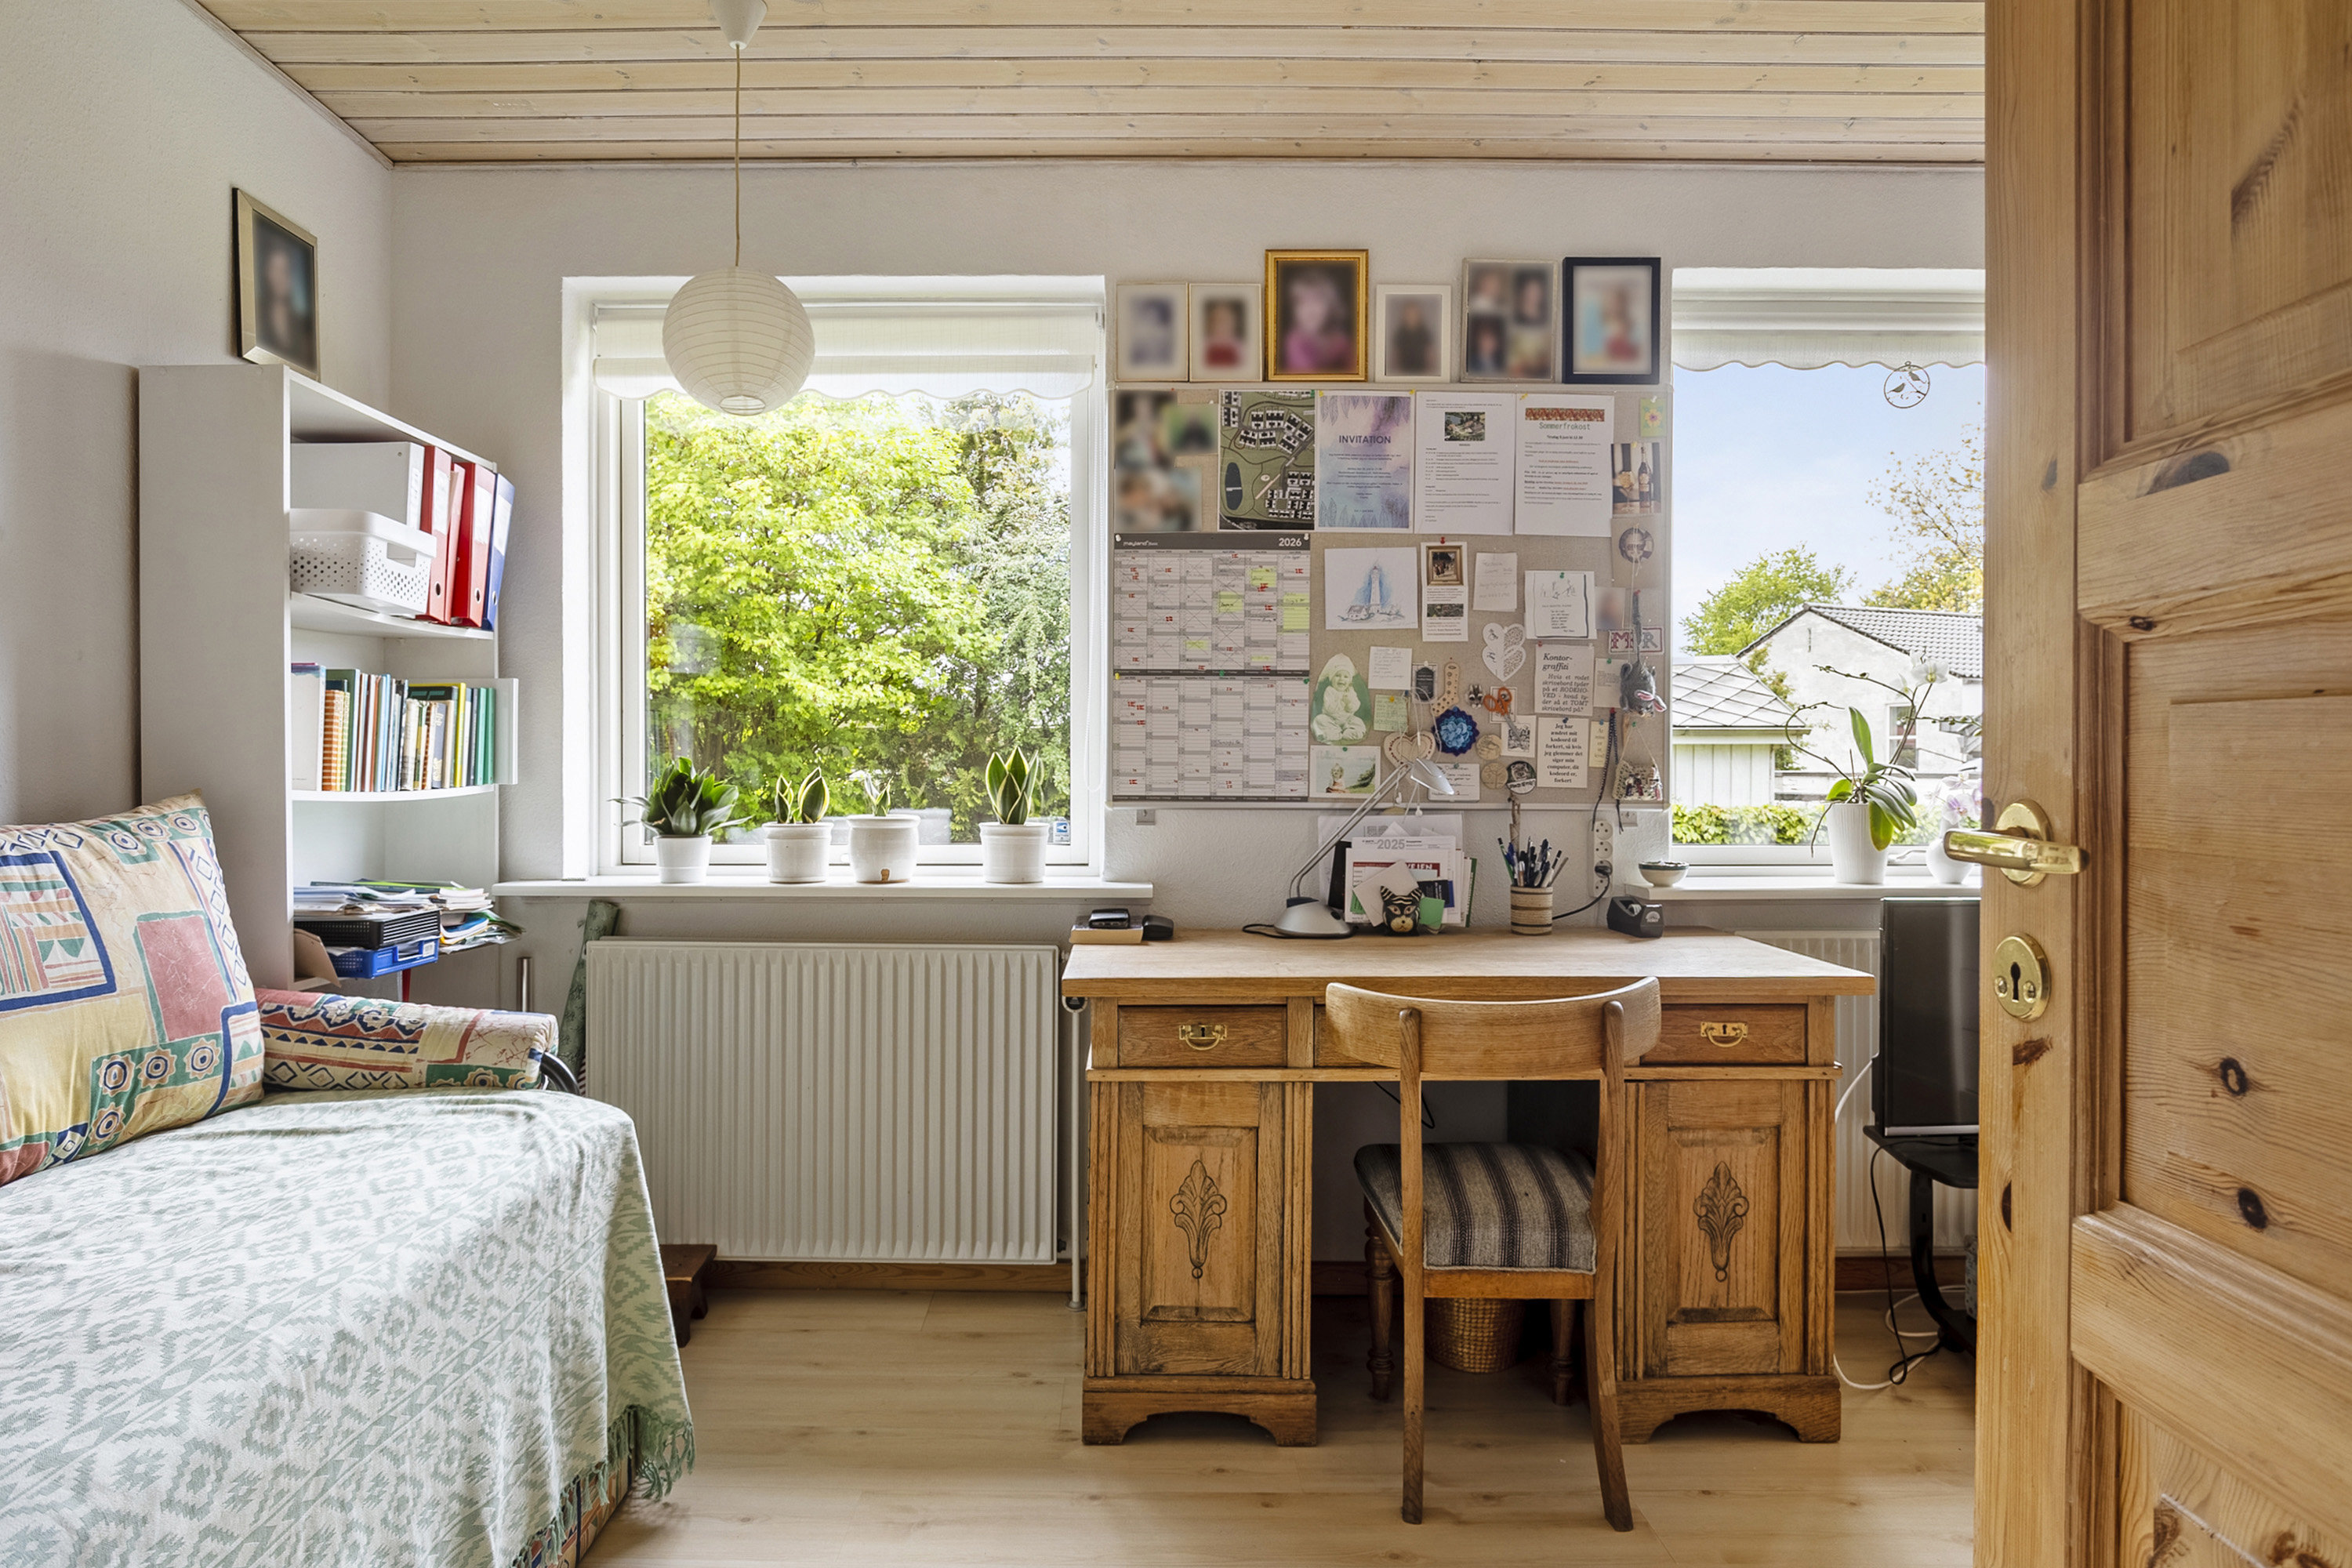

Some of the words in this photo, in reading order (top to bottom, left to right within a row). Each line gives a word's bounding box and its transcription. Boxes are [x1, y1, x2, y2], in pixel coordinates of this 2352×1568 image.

[1539, 422, 1591, 430] Sommerfrokost
[1339, 435, 1391, 444] INVITATION
[1278, 538, 1302, 546] 2026
[1611, 632, 1633, 649] M
[1642, 632, 1658, 649] R
[1543, 652, 1573, 661] Kontor-
[1542, 662, 1569, 672] graffiti
[1377, 839, 1405, 850] 2025
